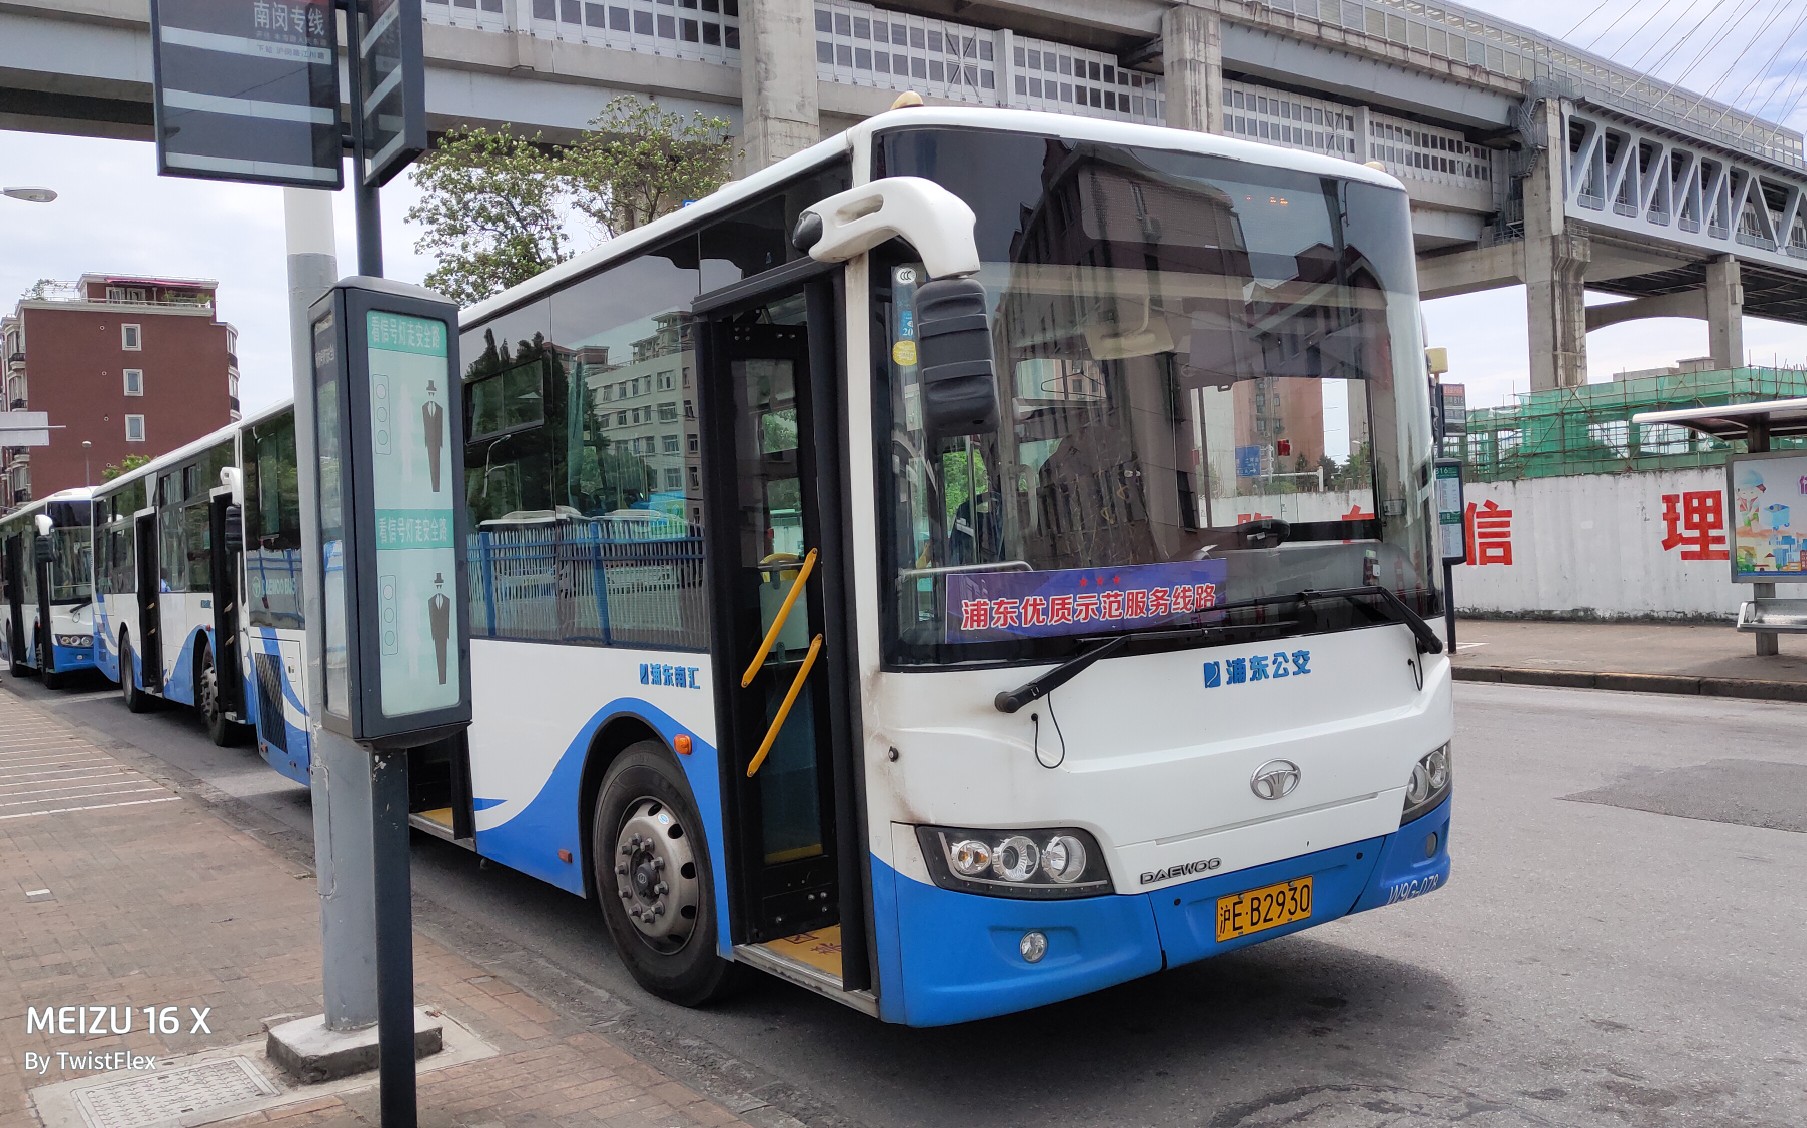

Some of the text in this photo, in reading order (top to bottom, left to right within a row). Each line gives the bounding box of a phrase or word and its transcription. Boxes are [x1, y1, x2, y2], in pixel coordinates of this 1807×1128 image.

[253, 1, 325, 36] 南闵专线
[371, 316, 440, 349] 看信号灯走安全路
[379, 515, 447, 544] 看信号灯走安全路
[1465, 490, 1730, 566] 信 理
[961, 583, 1217, 631] 浦东优质示范服务线路
[650, 663, 700, 689] 浦东南汇
[1226, 650, 1311, 685] 浦东公交
[1140, 857, 1222, 885] DAEWOO
